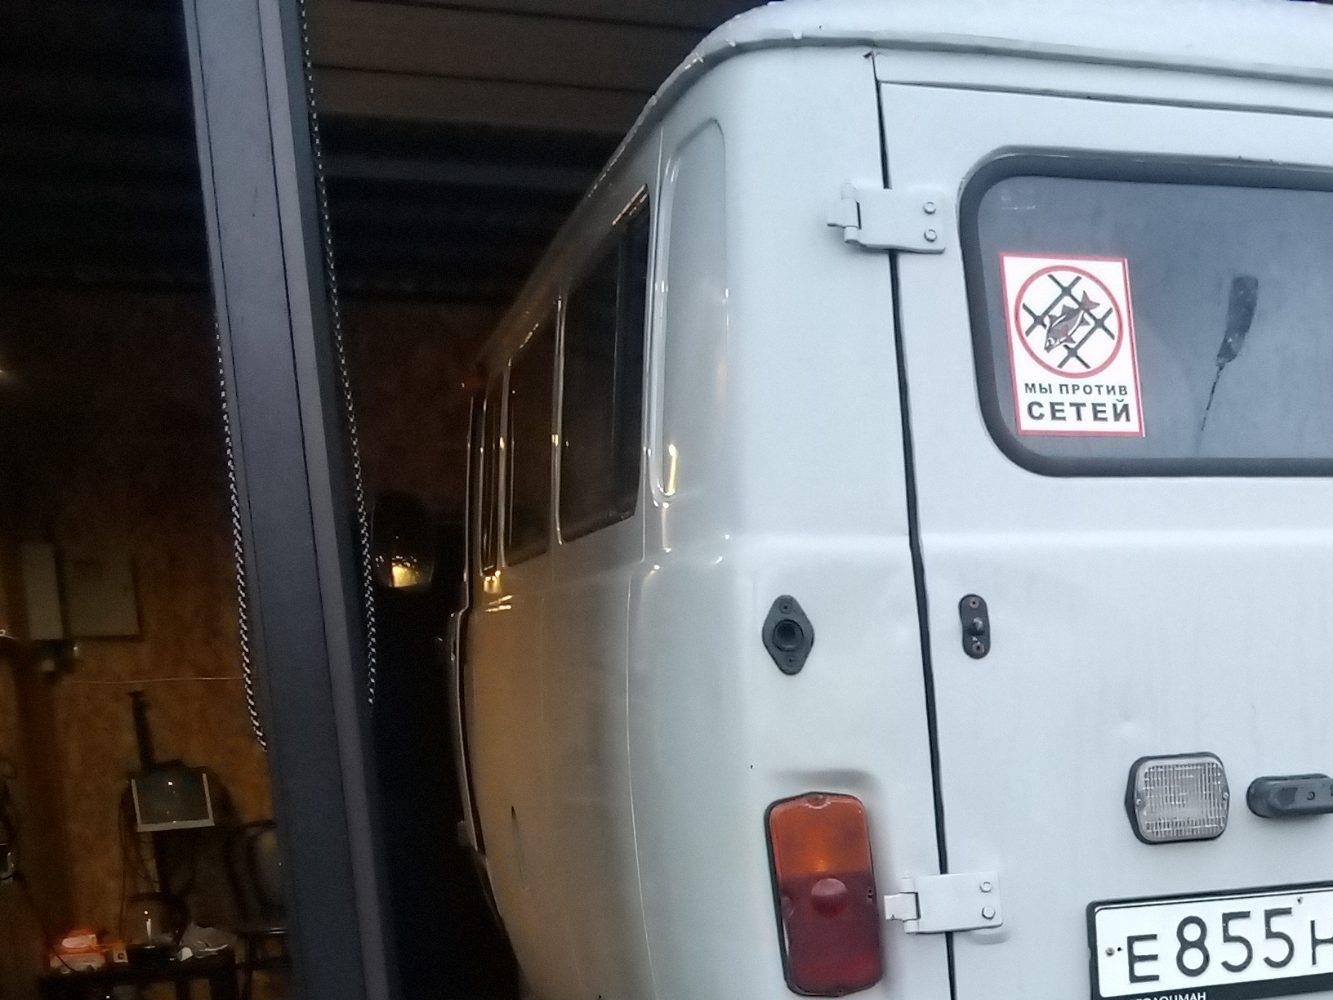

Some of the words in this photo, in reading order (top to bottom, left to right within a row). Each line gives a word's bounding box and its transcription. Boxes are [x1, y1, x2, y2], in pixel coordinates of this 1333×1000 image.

[1024, 382, 1053, 395] МЫ
[1058, 383, 1128, 396] ПРОТИВ
[1027, 398, 1131, 422] СЕТЕЙ
